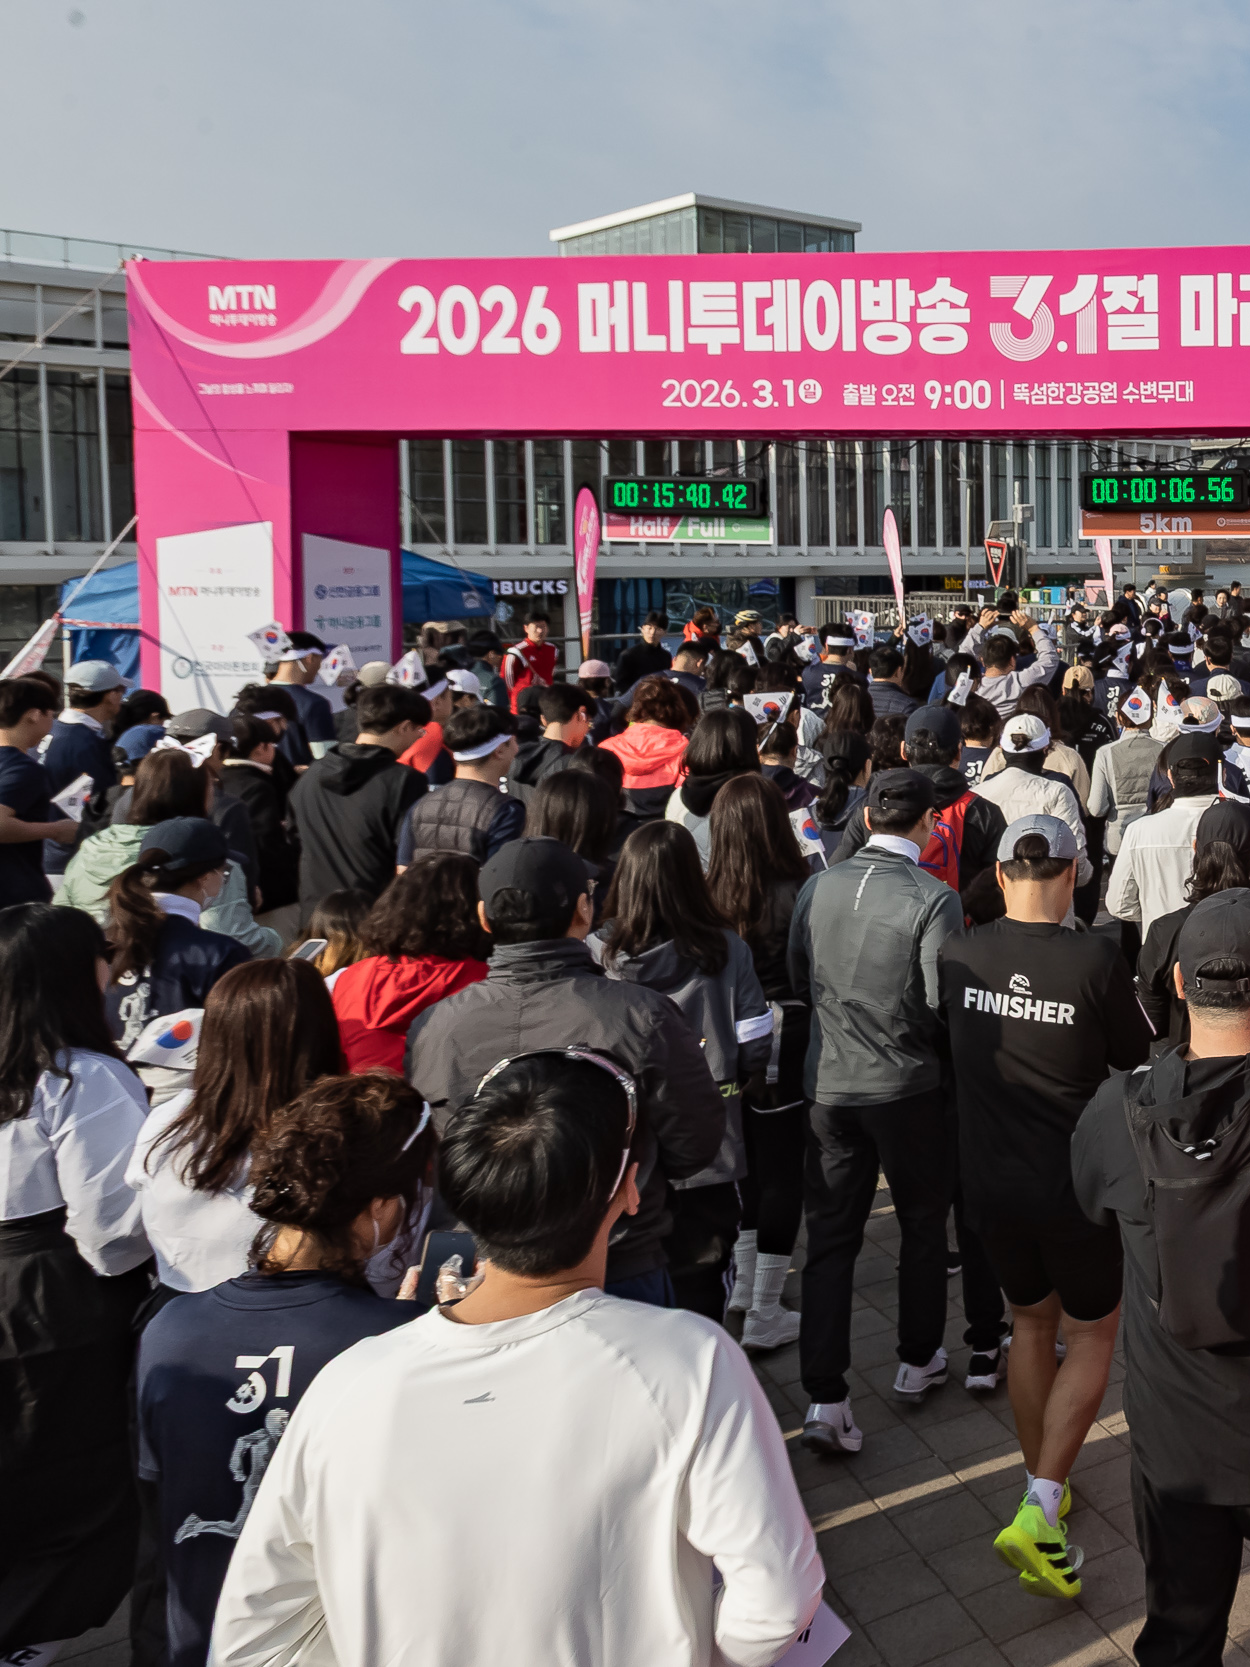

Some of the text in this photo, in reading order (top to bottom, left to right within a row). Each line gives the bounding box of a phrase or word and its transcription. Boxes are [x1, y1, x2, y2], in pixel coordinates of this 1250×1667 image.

[207, 284, 277, 311] MTN
[398, 284, 562, 356] 2026
[577, 276, 971, 356] 머니투데이방송
[989, 273, 1160, 362] 3.1절
[842, 382, 878, 406] 출발
[881, 383, 916, 406] 오전
[923, 379, 992, 410] 9:00
[1013, 382, 1118, 406] 뚝섬한강공원
[1122, 380, 1194, 404] 수변무대
[613, 481, 748, 509] 00:15:40.42
[1092, 477, 1235, 504] 00:00:06.56
[629, 516, 670, 537] Half
[687, 517, 726, 537] Full
[1140, 513, 1192, 533] 5km
[168, 586, 198, 597] MTN
[944, 577, 962, 589] bhc
[963, 986, 1076, 1025] FINISHER
